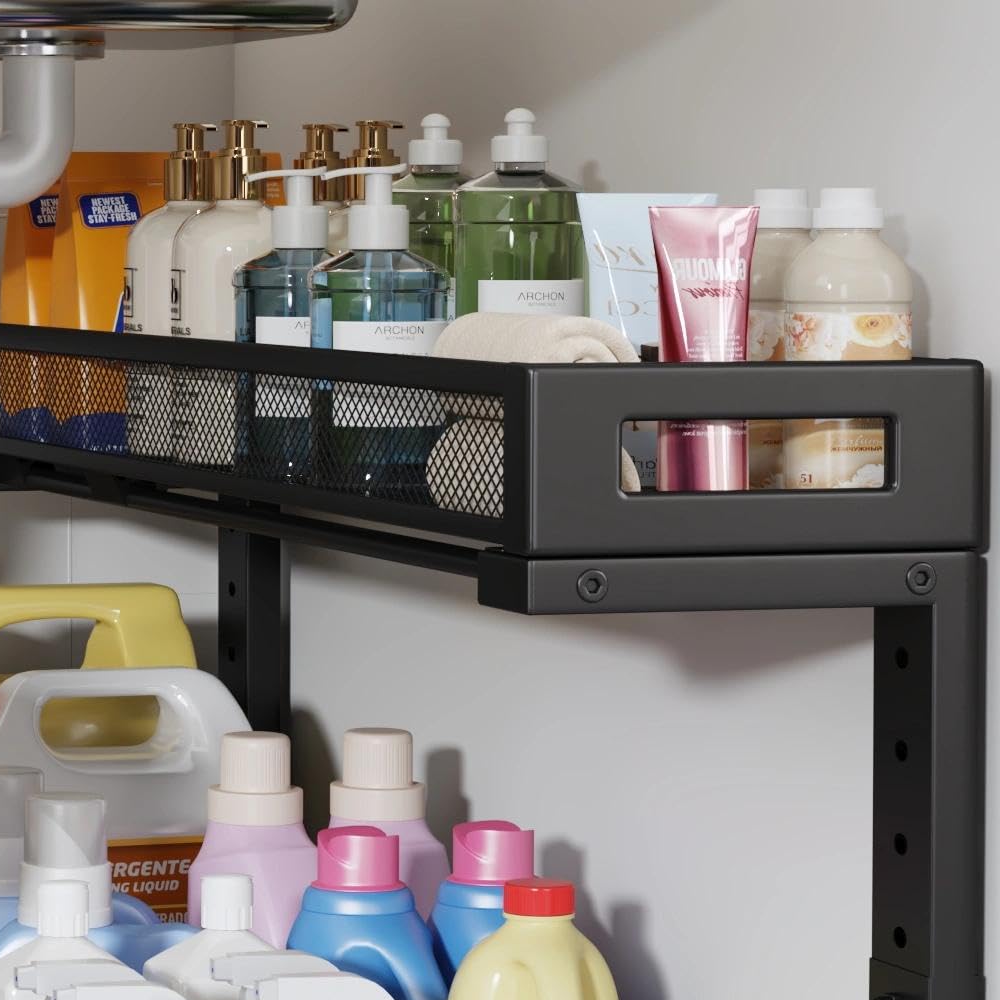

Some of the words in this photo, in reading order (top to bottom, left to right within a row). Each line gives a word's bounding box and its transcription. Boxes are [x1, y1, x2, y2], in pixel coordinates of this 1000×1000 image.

[91, 196, 125, 207] NEWEST
[92, 204, 130, 214] PACKAGE
[88, 212, 137, 224] STAY-FRESH
[517, 291, 566, 301] ARCHON
[374, 325, 425, 336] ARCHON
[111, 859, 191, 877] RGENTE
[133, 880, 180, 894] LIQUID
